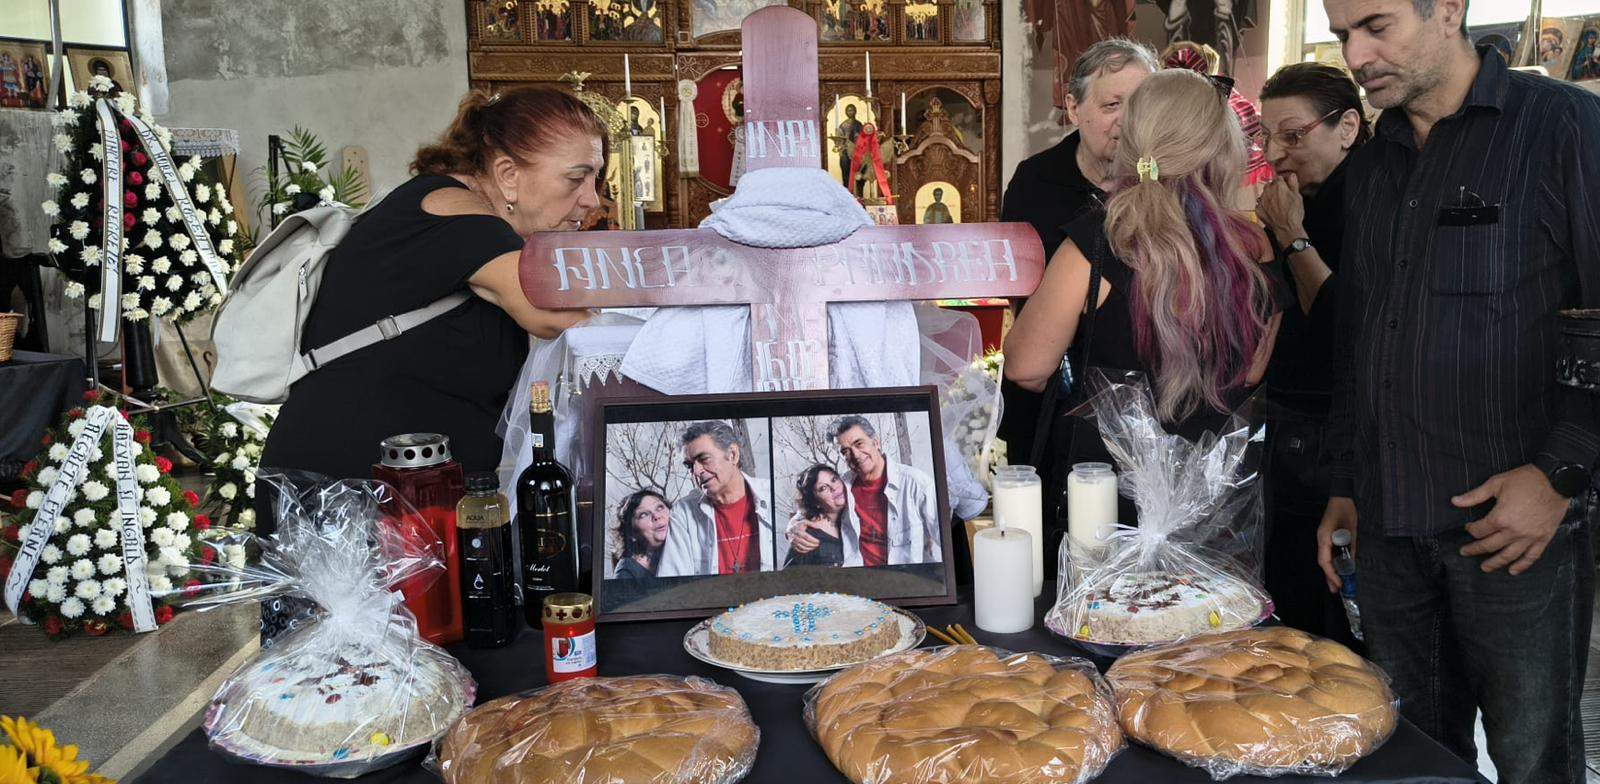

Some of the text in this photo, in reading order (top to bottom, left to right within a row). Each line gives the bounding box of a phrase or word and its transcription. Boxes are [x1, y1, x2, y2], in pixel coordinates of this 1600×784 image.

[115, 424, 131, 482] RAZVAN
[20, 422, 101, 563] REGRETE ETERNE
[121, 511, 140, 565] INGRID
